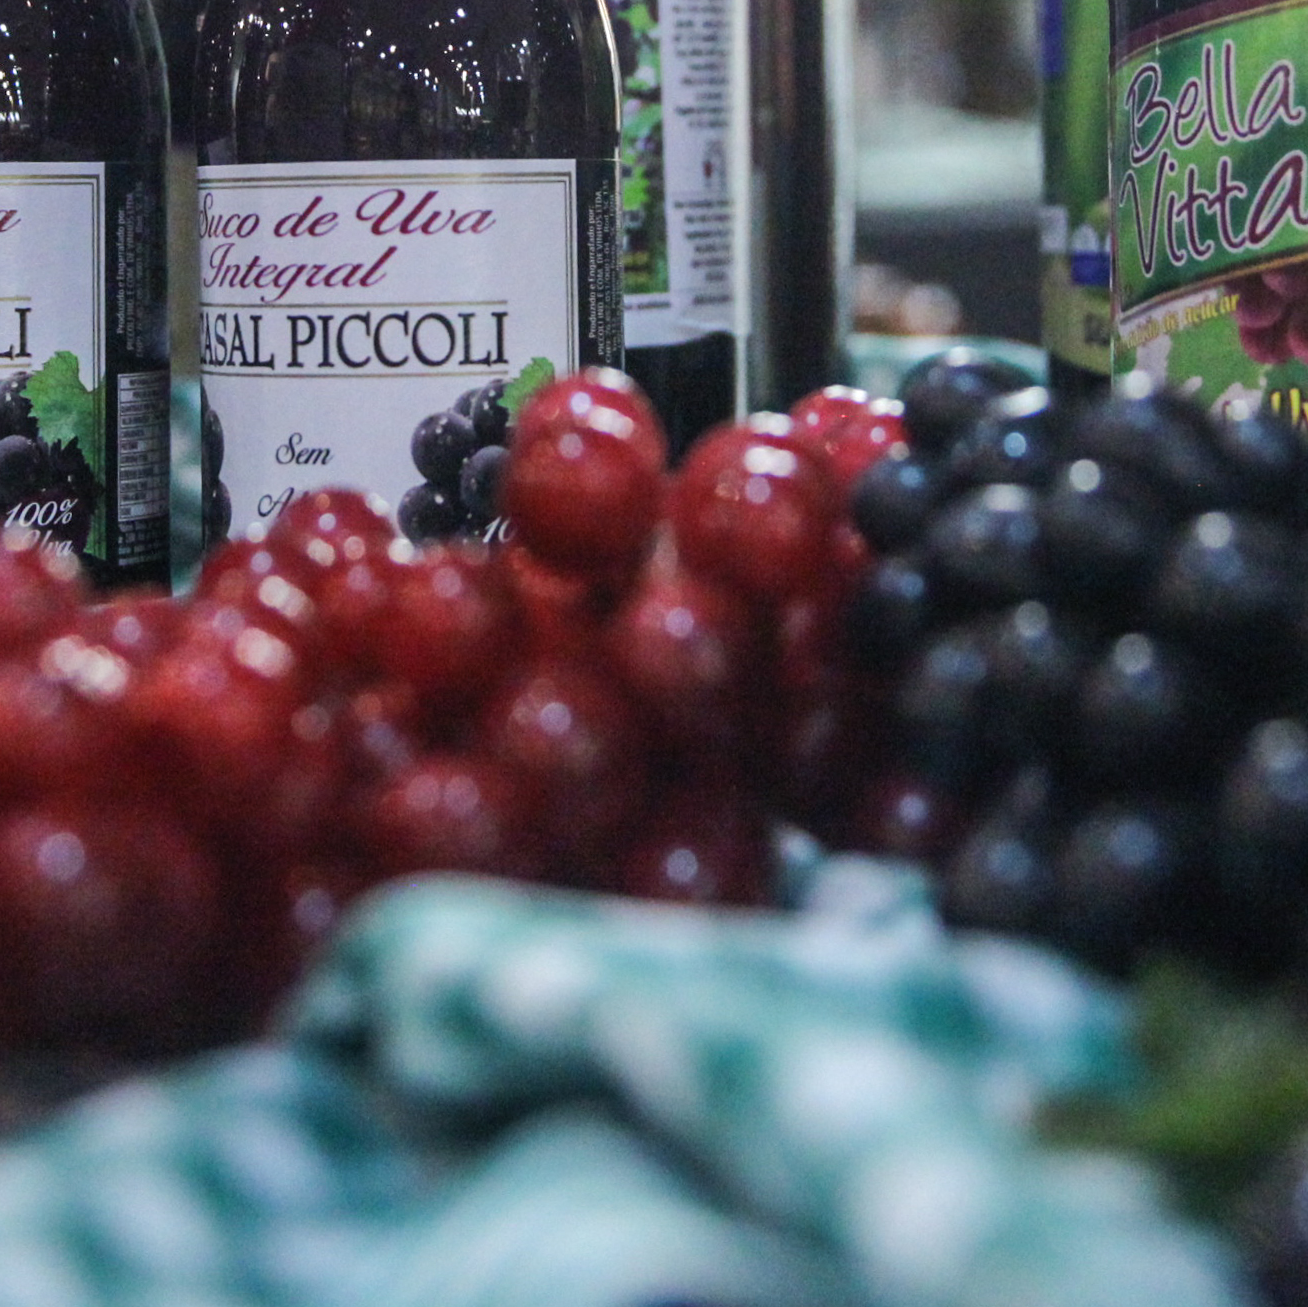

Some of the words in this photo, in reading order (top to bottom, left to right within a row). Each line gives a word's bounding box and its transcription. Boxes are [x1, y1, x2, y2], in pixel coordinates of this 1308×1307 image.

[1124, 39, 1306, 167] Bella
[199, 192, 260, 239] Suco
[273, 196, 339, 238] de
[355, 188, 497, 235] Uva
[204, 243, 398, 303] Integral
[200, 312, 275, 370] ASAL
[287, 311, 509, 370] PICCOLI
[275, 432, 332, 466] Sem
[4, 498, 79, 528] 100%
